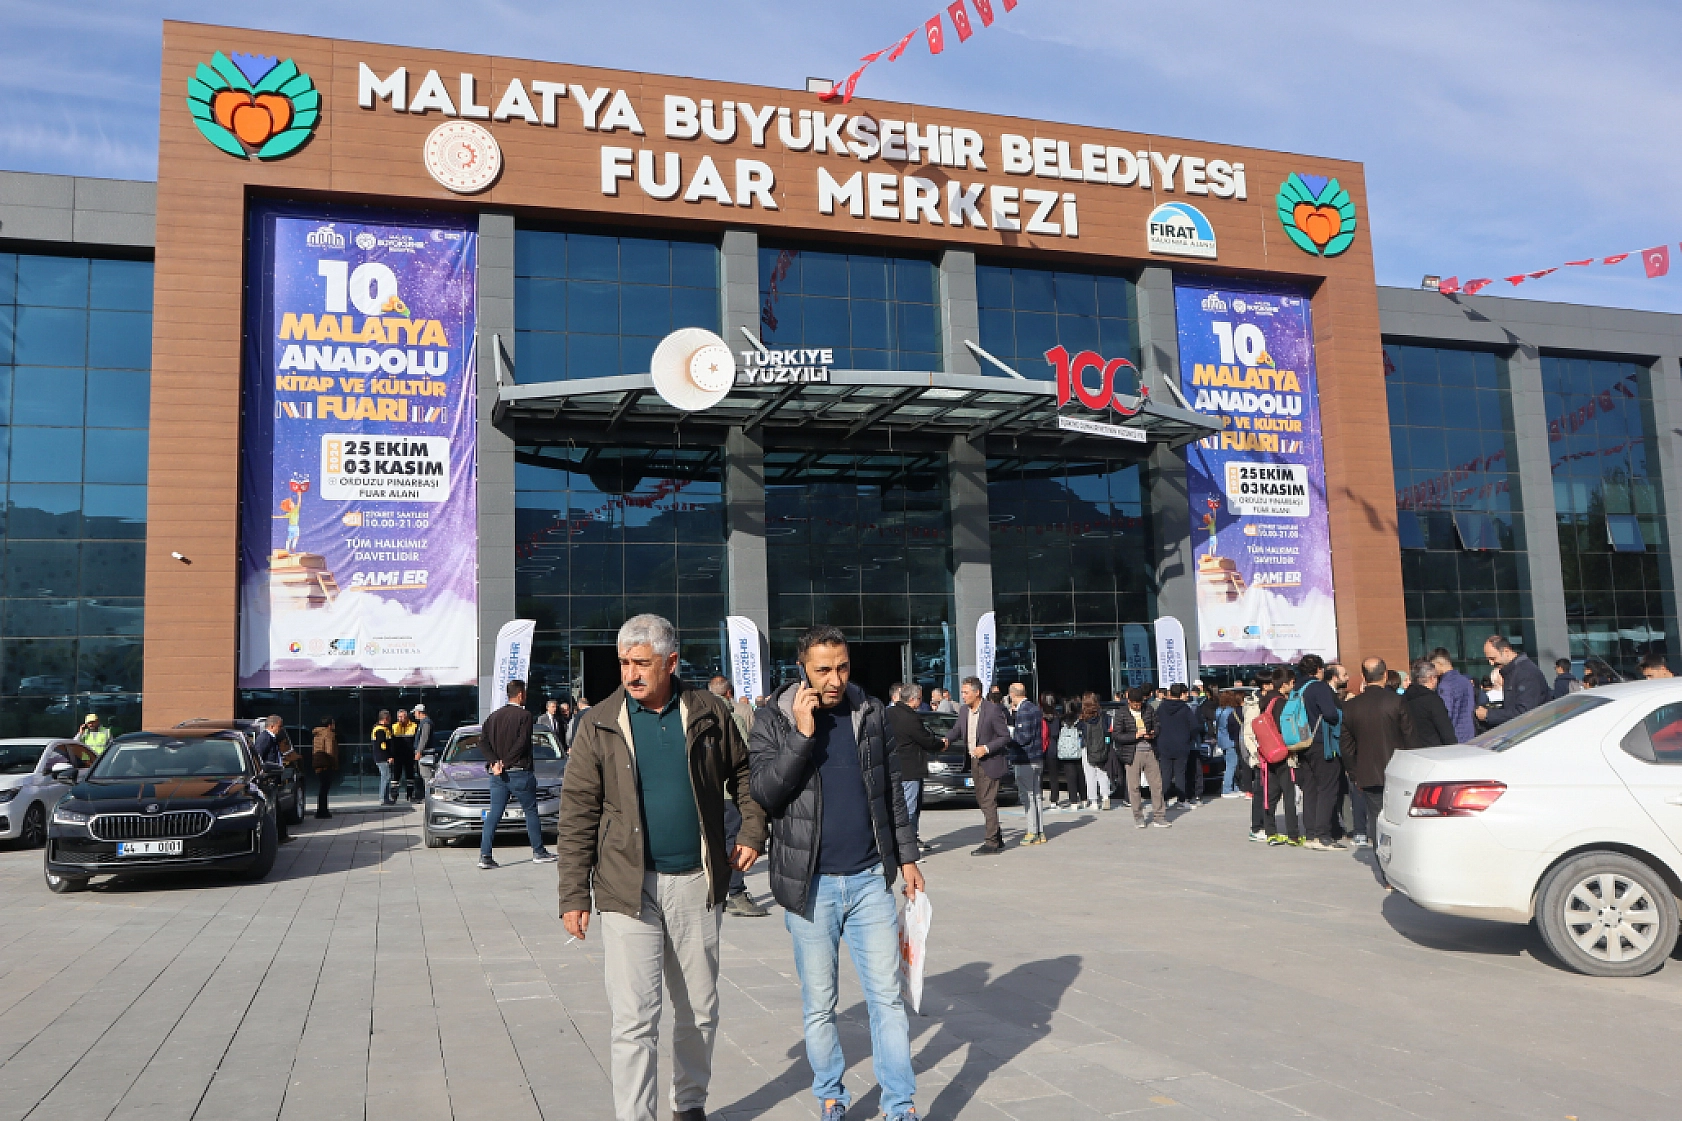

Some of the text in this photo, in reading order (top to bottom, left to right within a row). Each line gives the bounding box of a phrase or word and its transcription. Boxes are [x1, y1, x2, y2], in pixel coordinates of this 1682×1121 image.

[358, 61, 1247, 199] MALATYA BÜYÜKŞEHİR BELEDİYESİ
[600, 145, 1079, 238] FUAR MERKEZİ
[1150, 222, 1196, 240] FIRAT
[318, 259, 398, 316] 10
[278, 312, 449, 347] MALATYA
[1212, 321, 1266, 367] 10
[278, 344, 449, 376] ANADOLU
[275, 371, 447, 398] KİTAP VE KÜLTÜR
[1192, 363, 1302, 393] MALATYA
[316, 395, 409, 423] FUARI
[1195, 388, 1302, 416] ANADOLU
[1234, 415, 1251, 429] VE
[1254, 414, 1302, 433] KÜLTÜR
[344, 437, 429, 457] 25 EKİM
[1220, 430, 1279, 453] FUARI
[344, 459, 444, 476] 03 KASIM
[1240, 465, 1294, 481] 25 EKİM
[1240, 482, 1305, 496] 03 KASIM
[346, 536, 428, 549] TÜM HALKIMIZ
[352, 569, 429, 586] SAMİ ER
